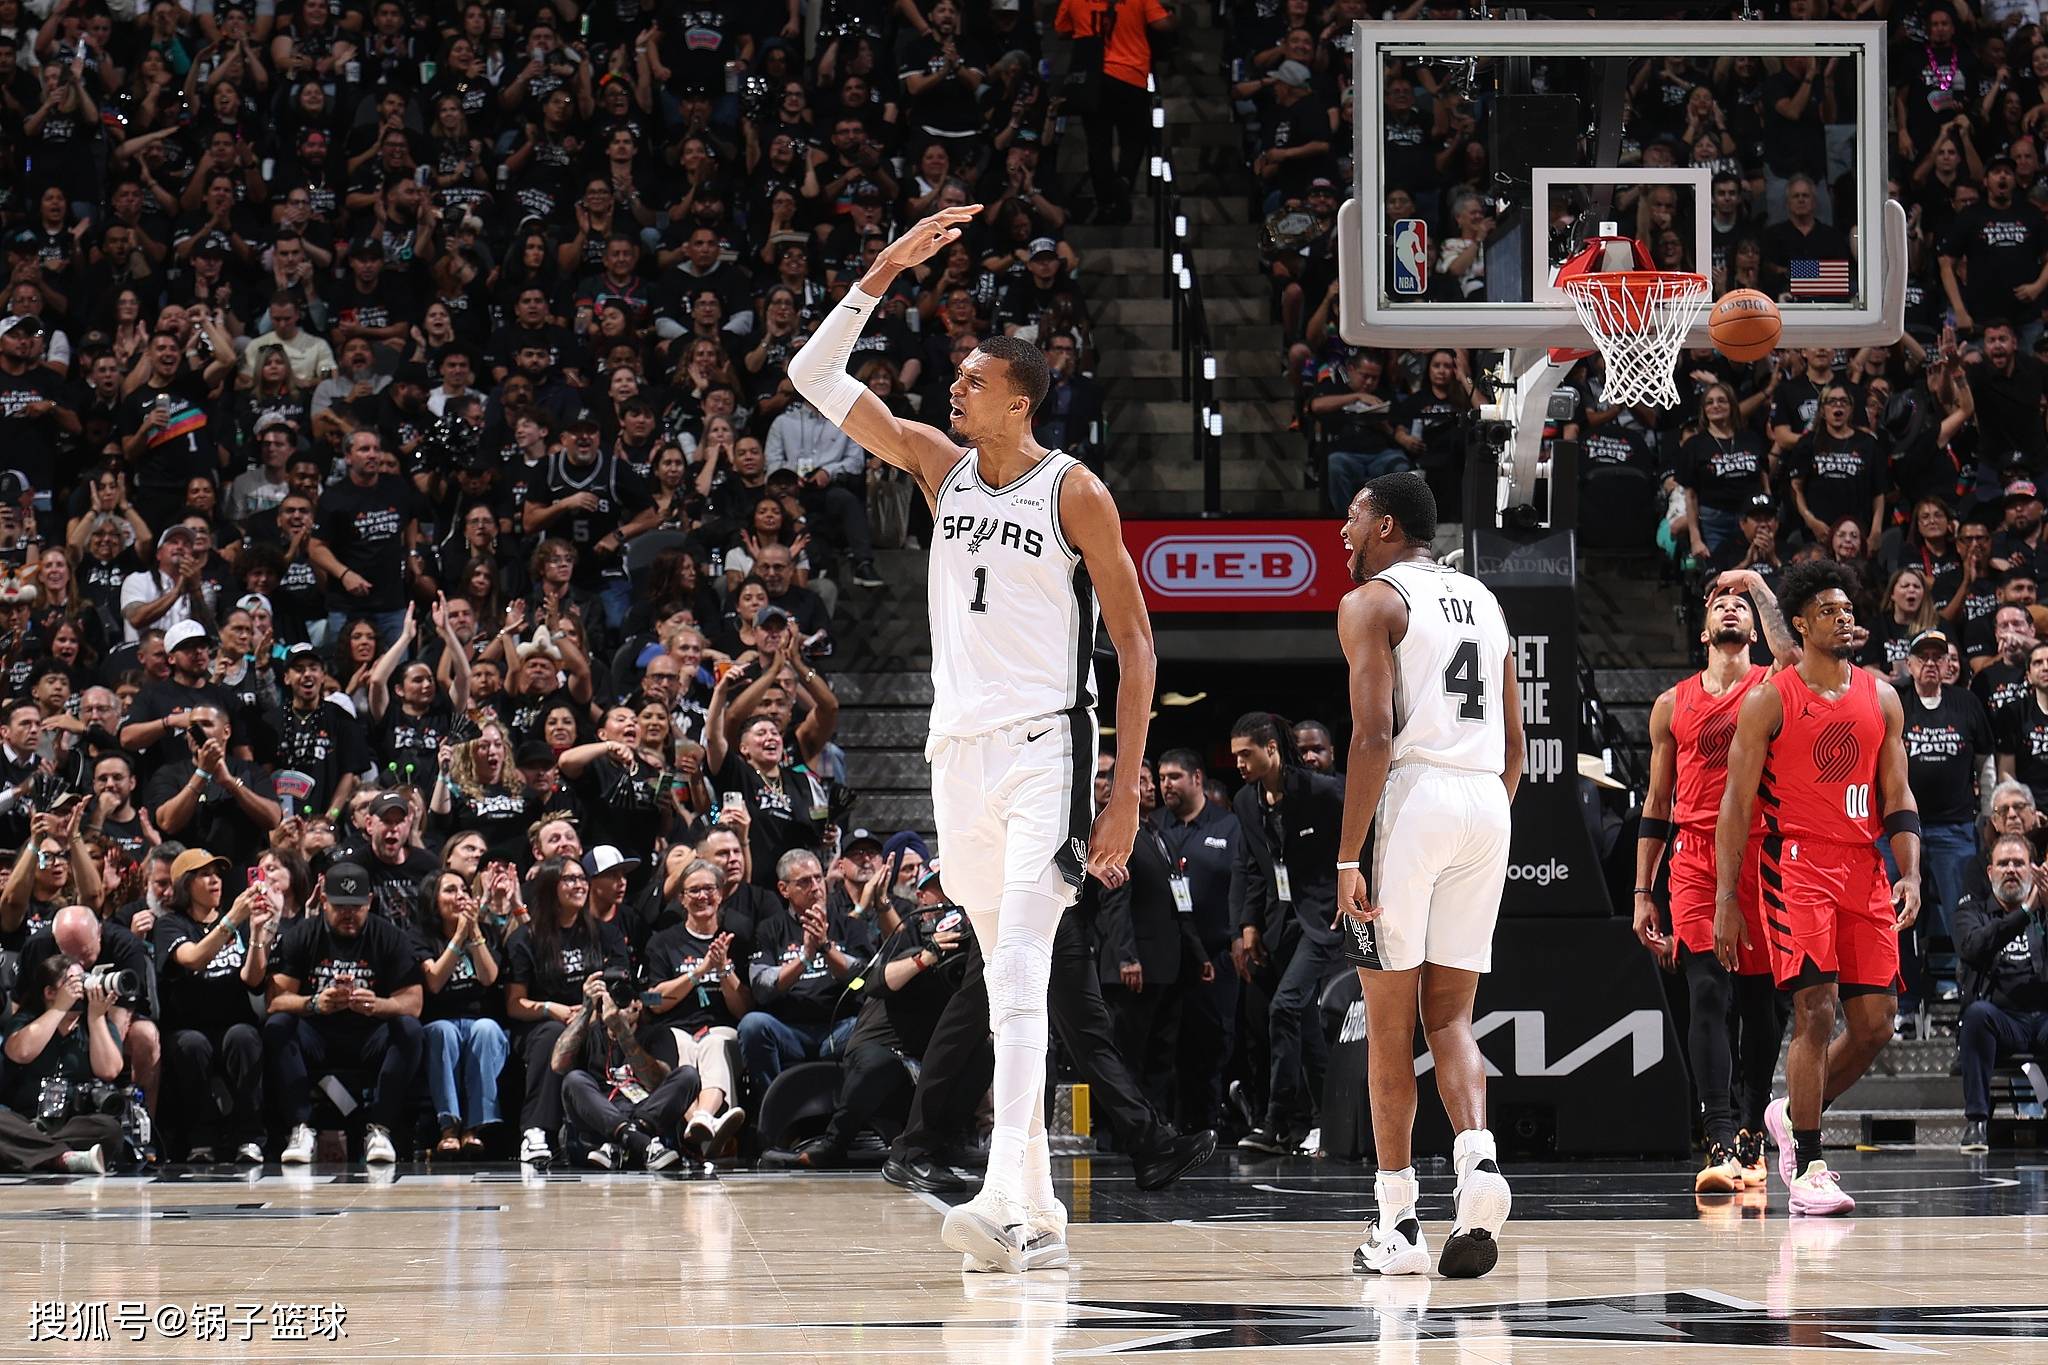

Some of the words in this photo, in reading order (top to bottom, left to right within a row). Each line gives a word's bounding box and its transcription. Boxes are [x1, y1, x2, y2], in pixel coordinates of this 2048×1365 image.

[1398, 276, 1415, 289] NBA
[187, 431, 199, 453] 1
[1588, 446, 1627, 462] LOUD
[1715, 461, 1757, 477] LOUD
[1817, 462, 1857, 476] LOUD
[1015, 498, 1040, 507] LEDGER
[359, 521, 399, 539] LOUD
[573, 519, 590, 542] 5
[943, 516, 1043, 557] SPURS
[1165, 552, 1293, 579] H-E-B
[1477, 555, 1571, 576] SPALDING
[968, 565, 988, 614] 1
[1438, 597, 1475, 626] FOX
[1442, 637, 1488, 725] 4
[1517, 682, 1550, 725] HE
[394, 736, 437, 750] LOD
[1907, 732, 1930, 742] SAN
[1930, 733, 1960, 743] ANTO
[1909, 741, 1958, 757] LOUD
[1845, 783, 1870, 819] 00
[1506, 857, 1569, 886] oogle
[333, 960, 358, 969] Puro
